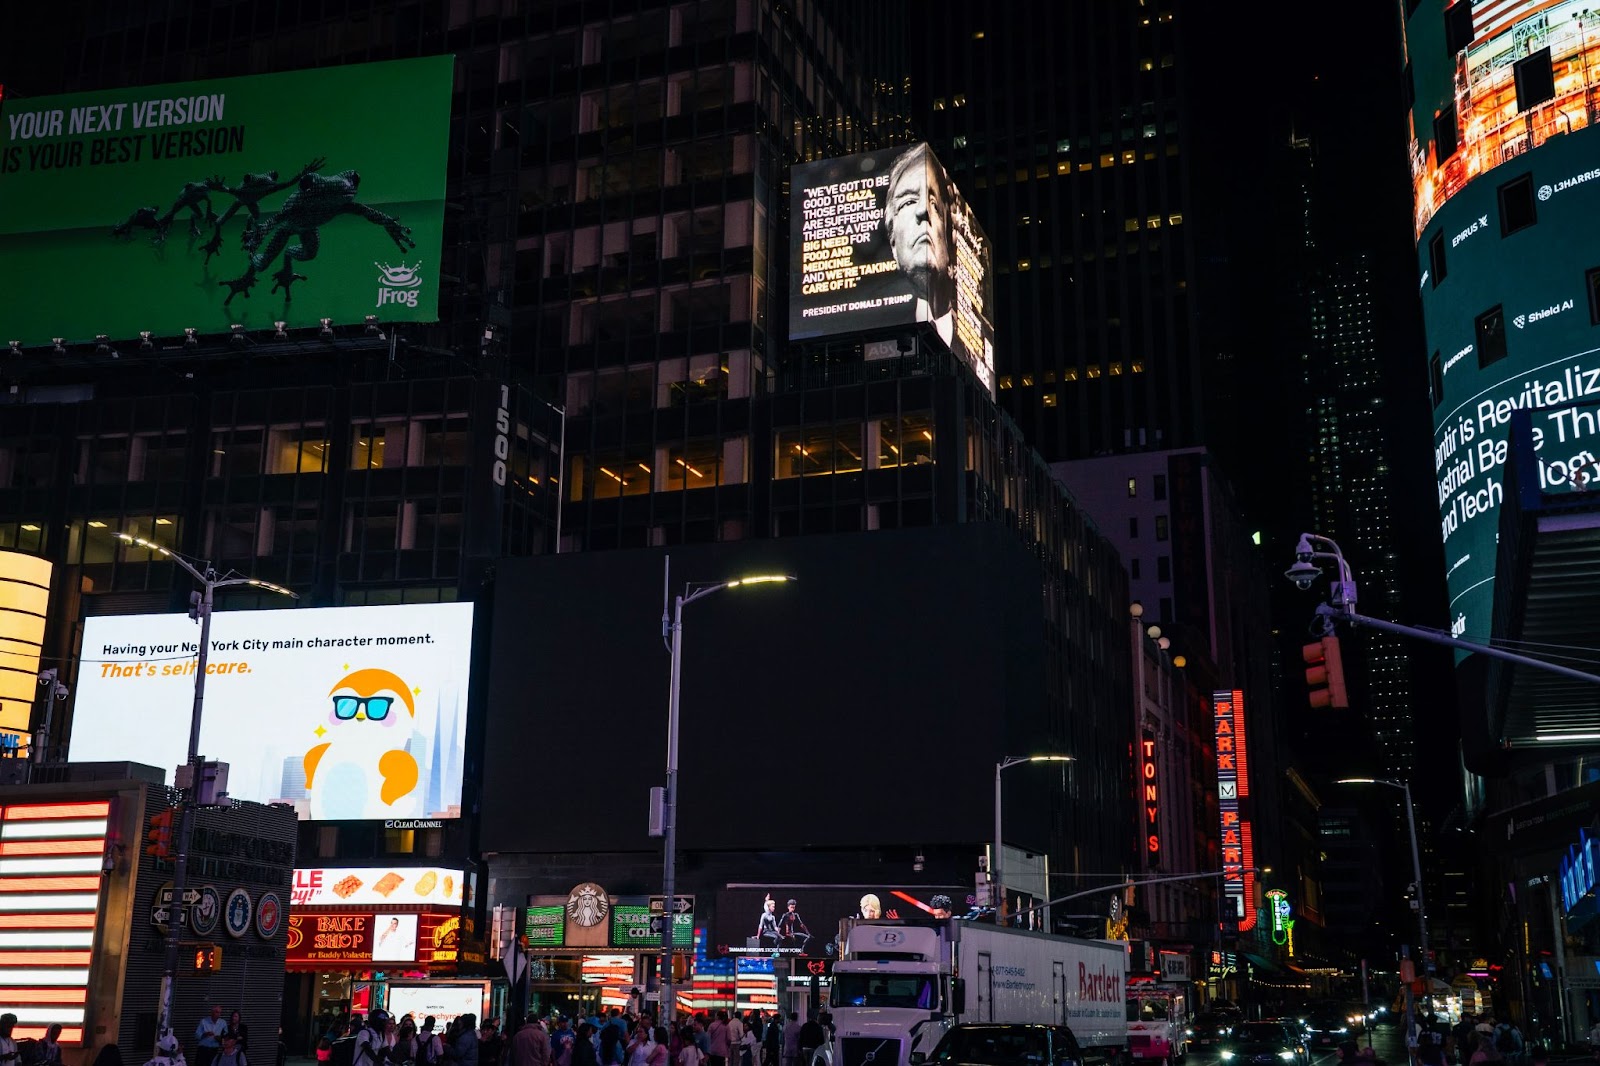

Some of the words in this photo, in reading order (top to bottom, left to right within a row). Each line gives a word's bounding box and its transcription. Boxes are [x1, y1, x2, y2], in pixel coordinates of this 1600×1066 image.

[9, 108, 64, 140] YOUR
[68, 103, 128, 135] NEXT
[131, 94, 226, 129] VERSION
[1, 145, 24, 174] IS
[29, 140, 81, 172] YOUR
[91, 136, 146, 167] BEST
[150, 126, 245, 161] VERSION
[840, 180, 860, 191] GOT
[860, 178, 874, 189] TO
[875, 175, 890, 187] BE
[1553, 168, 1600, 193] L3HARRIS
[803, 196, 831, 210] GOOD
[832, 193, 845, 205] TO
[846, 189, 876, 202] GAZA.
[803, 205, 836, 220] THOSE
[837, 198, 877, 215] PEOPLE
[802, 218, 824, 231] ARE
[824, 208, 884, 228] SUFFERING!
[802, 226, 844, 241] THERE'S
[845, 224, 854, 235] A
[854, 219, 880, 233] VERY
[803, 241, 820, 252] BIG
[821, 235, 849, 249] NEED
[850, 232, 871, 245] FOR
[1452, 221, 1478, 248] EPIRUS
[803, 249, 830, 263] FOOD
[830, 245, 853, 258] AND
[802, 257, 854, 274] MEDICINE.
[802, 272, 825, 285] AND
[825, 266, 859, 280] WE'RE
[859, 260, 897, 275] TAKING
[376, 287, 420, 307] JFrog
[802, 281, 829, 295] CARE
[830, 279, 844, 291] OF
[802, 303, 848, 318] PRESIDENT
[848, 298, 882, 311] DONALD
[882, 293, 913, 306] TRUMP
[1528, 304, 1560, 324] Shield
[492, 384, 510, 486] 1500
[1458, 416, 1475, 445] is
[1477, 426, 1544, 473] Bae
[102, 642, 146, 657] Having
[149, 642, 178, 656] your
[181, 641, 201, 653] Ne
[211, 640, 240, 652] York
[242, 638, 269, 653] City
[271, 638, 304, 650] main
[306, 635, 373, 648] character
[375, 632, 435, 646] moment.
[100, 662, 156, 678] That's
[1217, 701, 1234, 770] PARK
[1223, 811, 1241, 881] PARK
[293, 870, 323, 888] LE
[317, 916, 365, 932] BAKE
[616, 913, 691, 925] STARKS
[313, 933, 364, 949] SHOP
[883, 933, 897, 943] B
[317, 951, 342, 960] Buddy
[1078, 961, 1120, 1003] Bartlett
